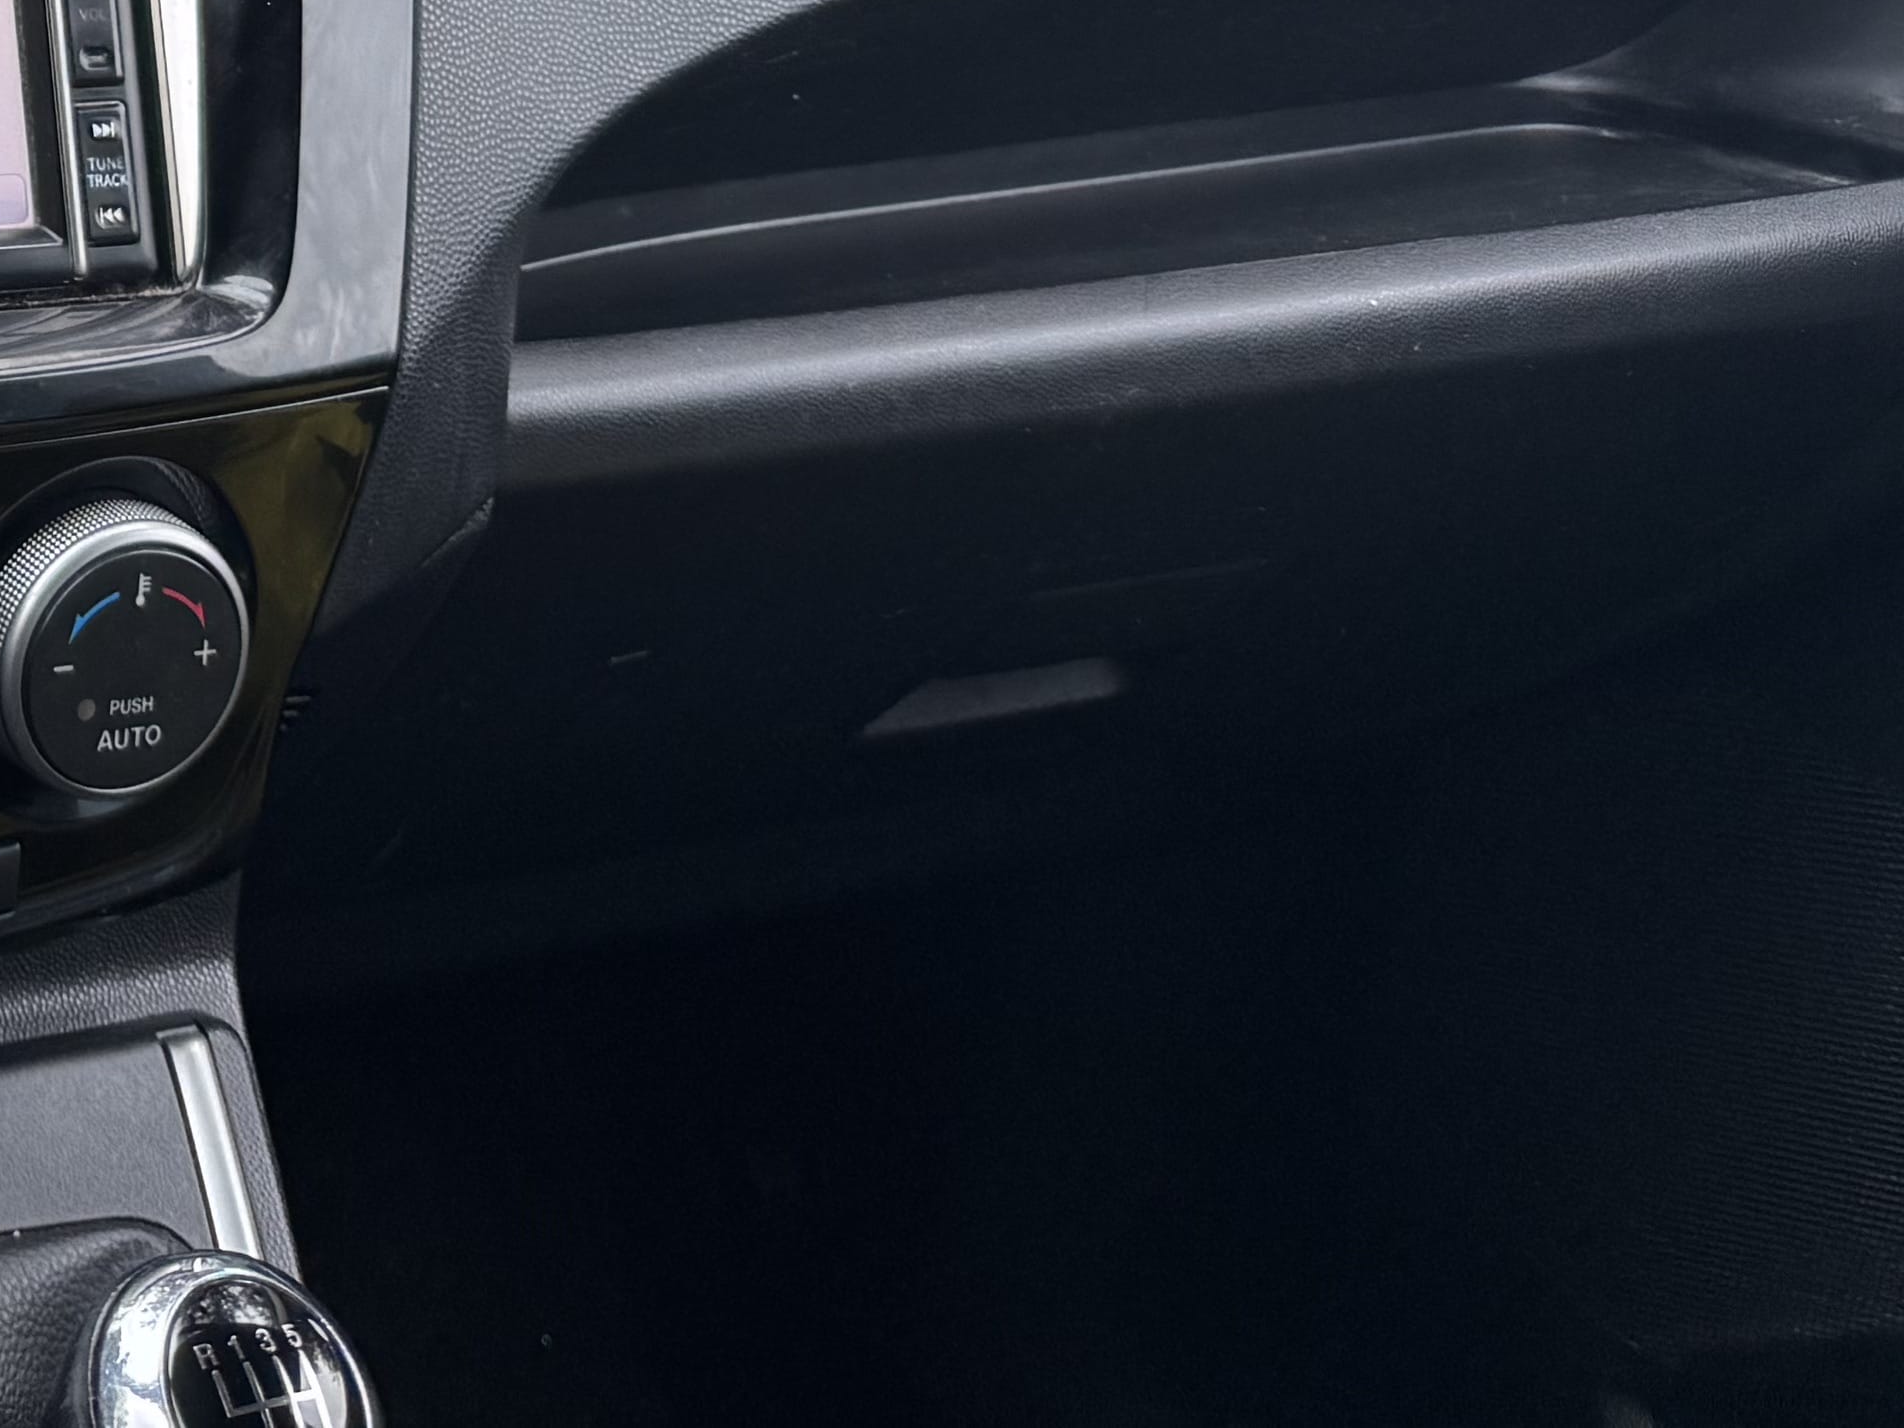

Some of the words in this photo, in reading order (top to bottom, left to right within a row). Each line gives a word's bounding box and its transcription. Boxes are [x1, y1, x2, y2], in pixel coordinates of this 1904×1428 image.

[86, 157, 125, 172] TUNE
[86, 172, 129, 189] TRACK
[107, 695, 154, 717] PUSH
[95, 722, 162, 753] AUTO
[281, 1322, 302, 1348] 5
